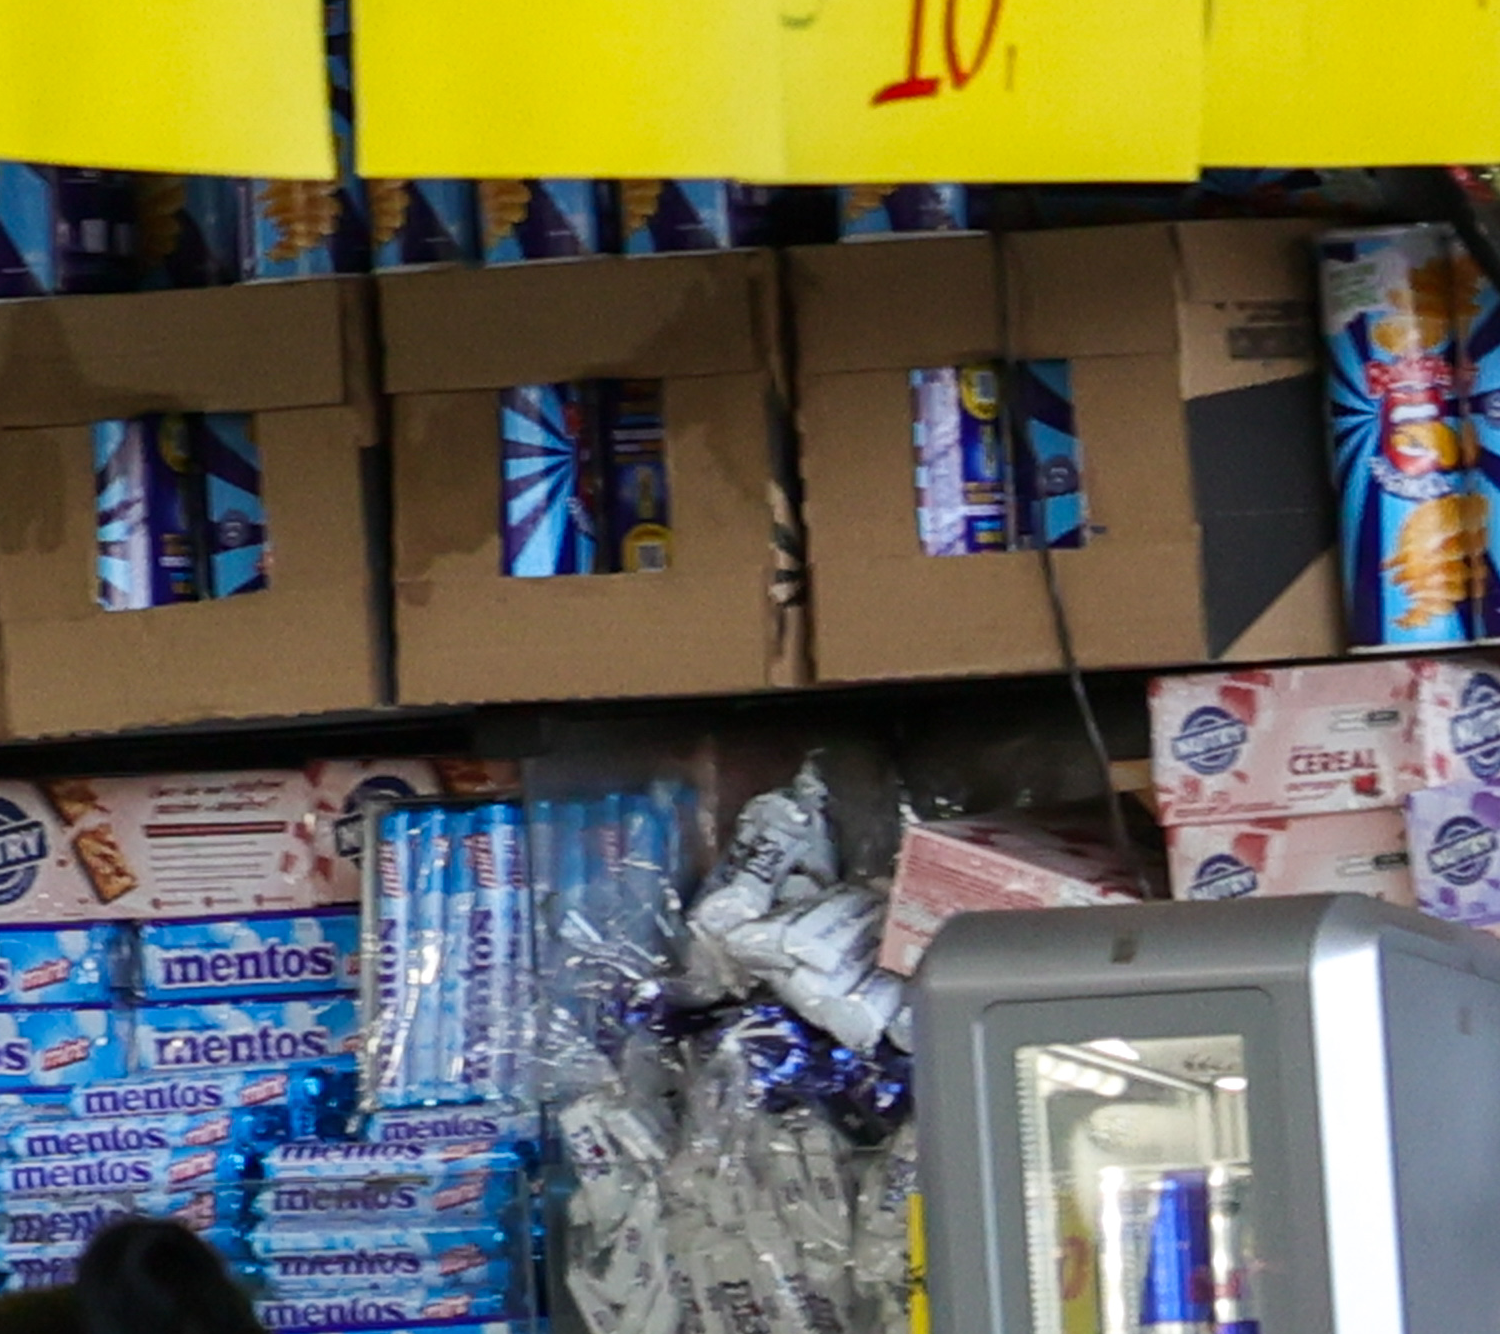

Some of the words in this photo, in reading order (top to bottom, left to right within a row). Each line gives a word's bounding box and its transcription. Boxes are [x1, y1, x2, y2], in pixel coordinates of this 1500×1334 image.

[161, 943, 337, 986] mentos
[151, 1028, 327, 1067] mentos
[84, 1080, 225, 1114] mentos
[26, 1124, 168, 1155] mentos
[10, 1158, 152, 1190] mentos
